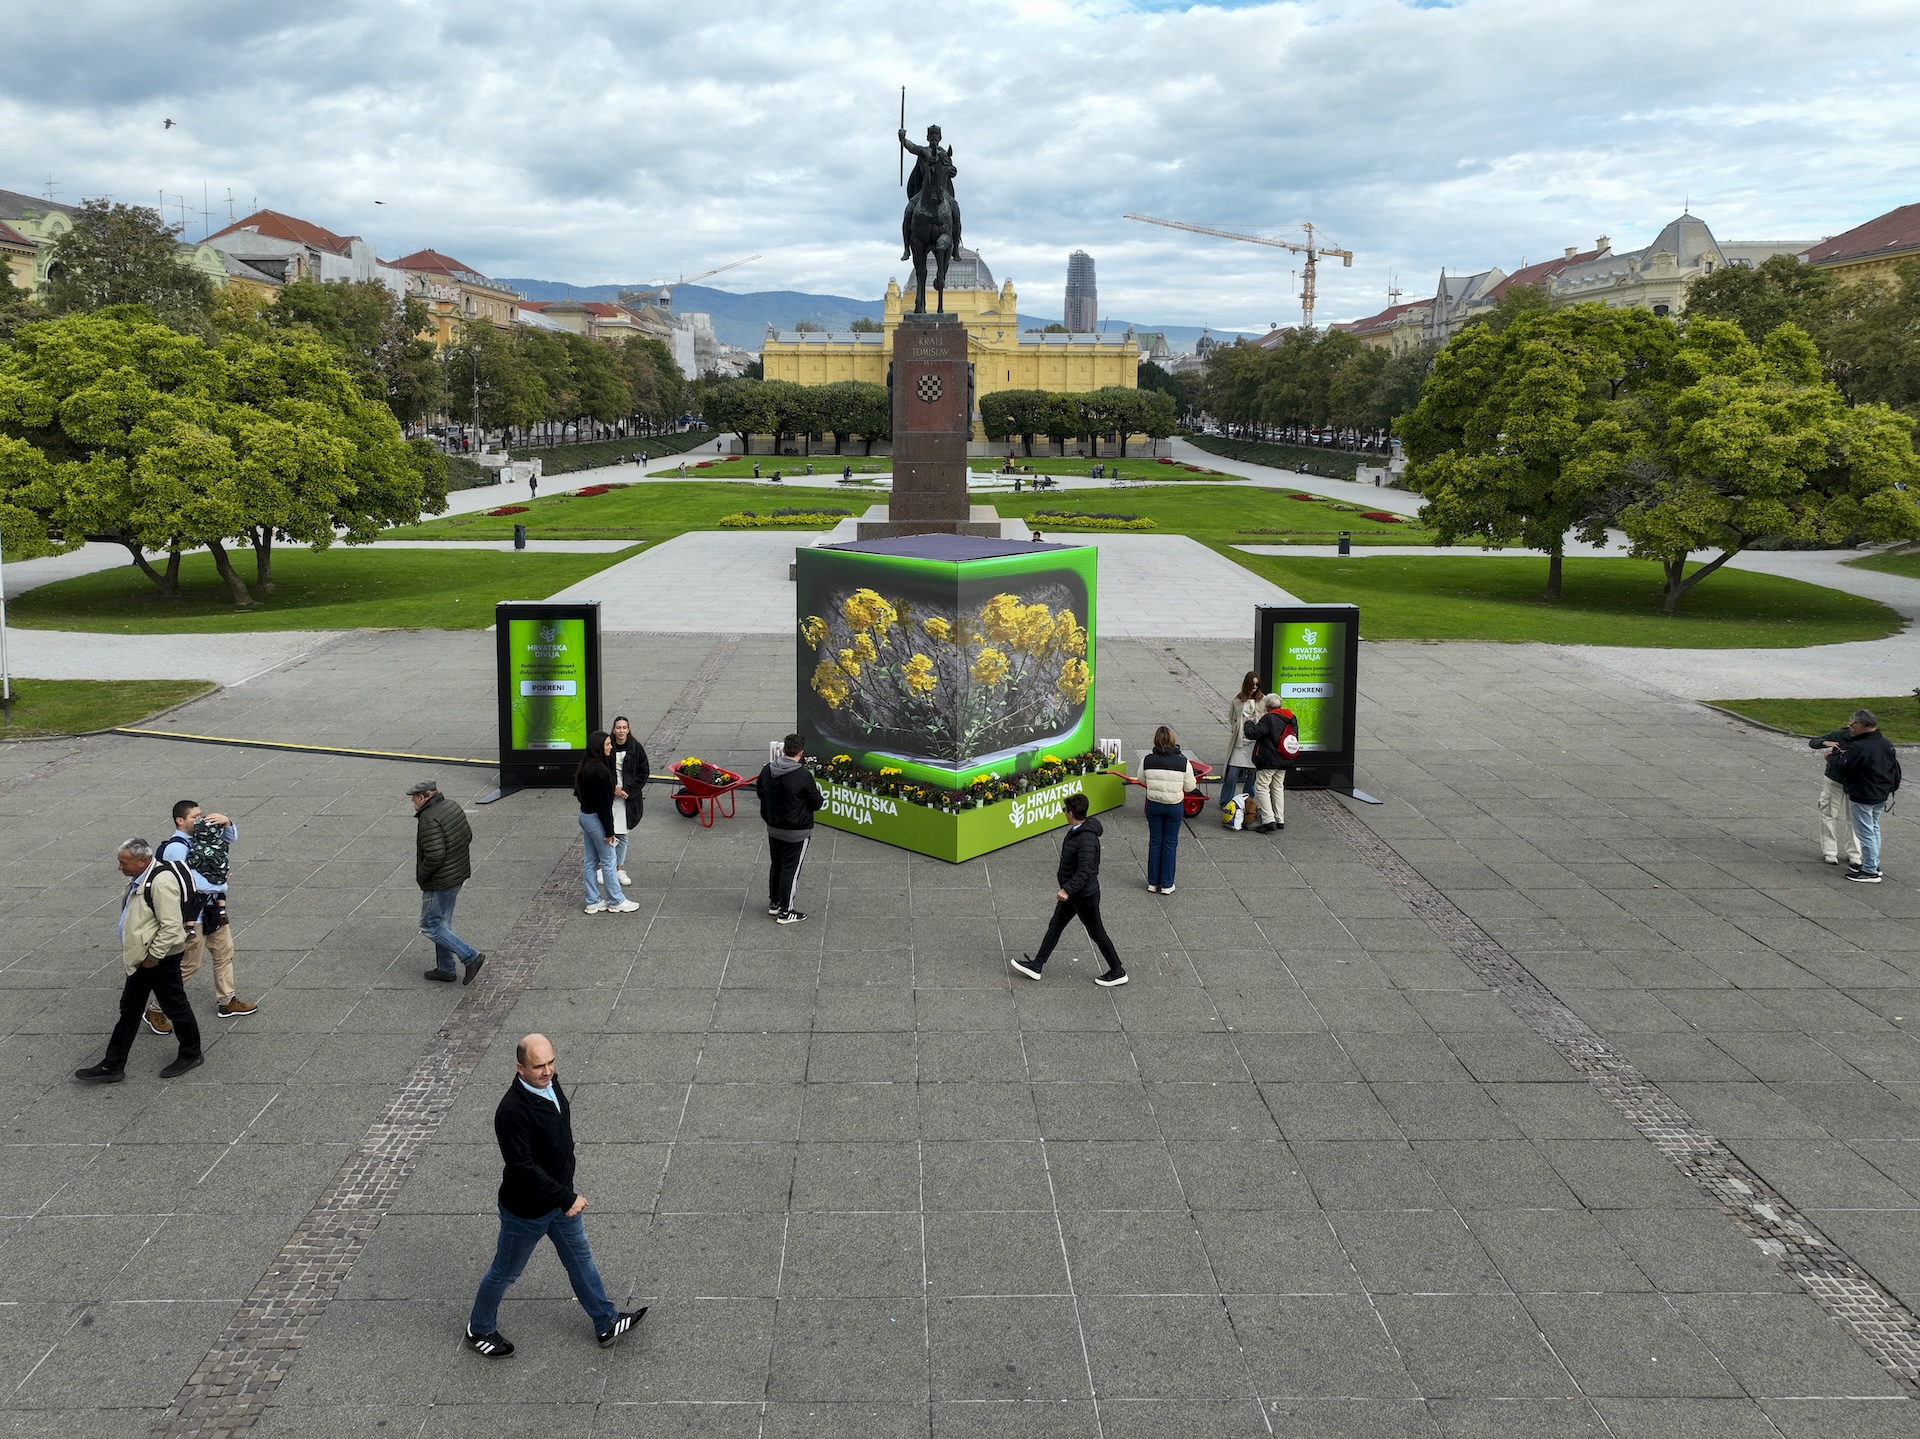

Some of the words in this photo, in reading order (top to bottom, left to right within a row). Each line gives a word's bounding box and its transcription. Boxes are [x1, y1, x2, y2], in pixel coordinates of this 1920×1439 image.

[911, 347, 950, 357] TOMISLAV
[918, 337, 943, 346] KRALJ
[831, 785, 898, 817] HRVATSKA
[1027, 779, 1083, 809] HRVATSKA
[831, 800, 873, 825] DIVLJA
[1026, 800, 1063, 825] DIVLJA
